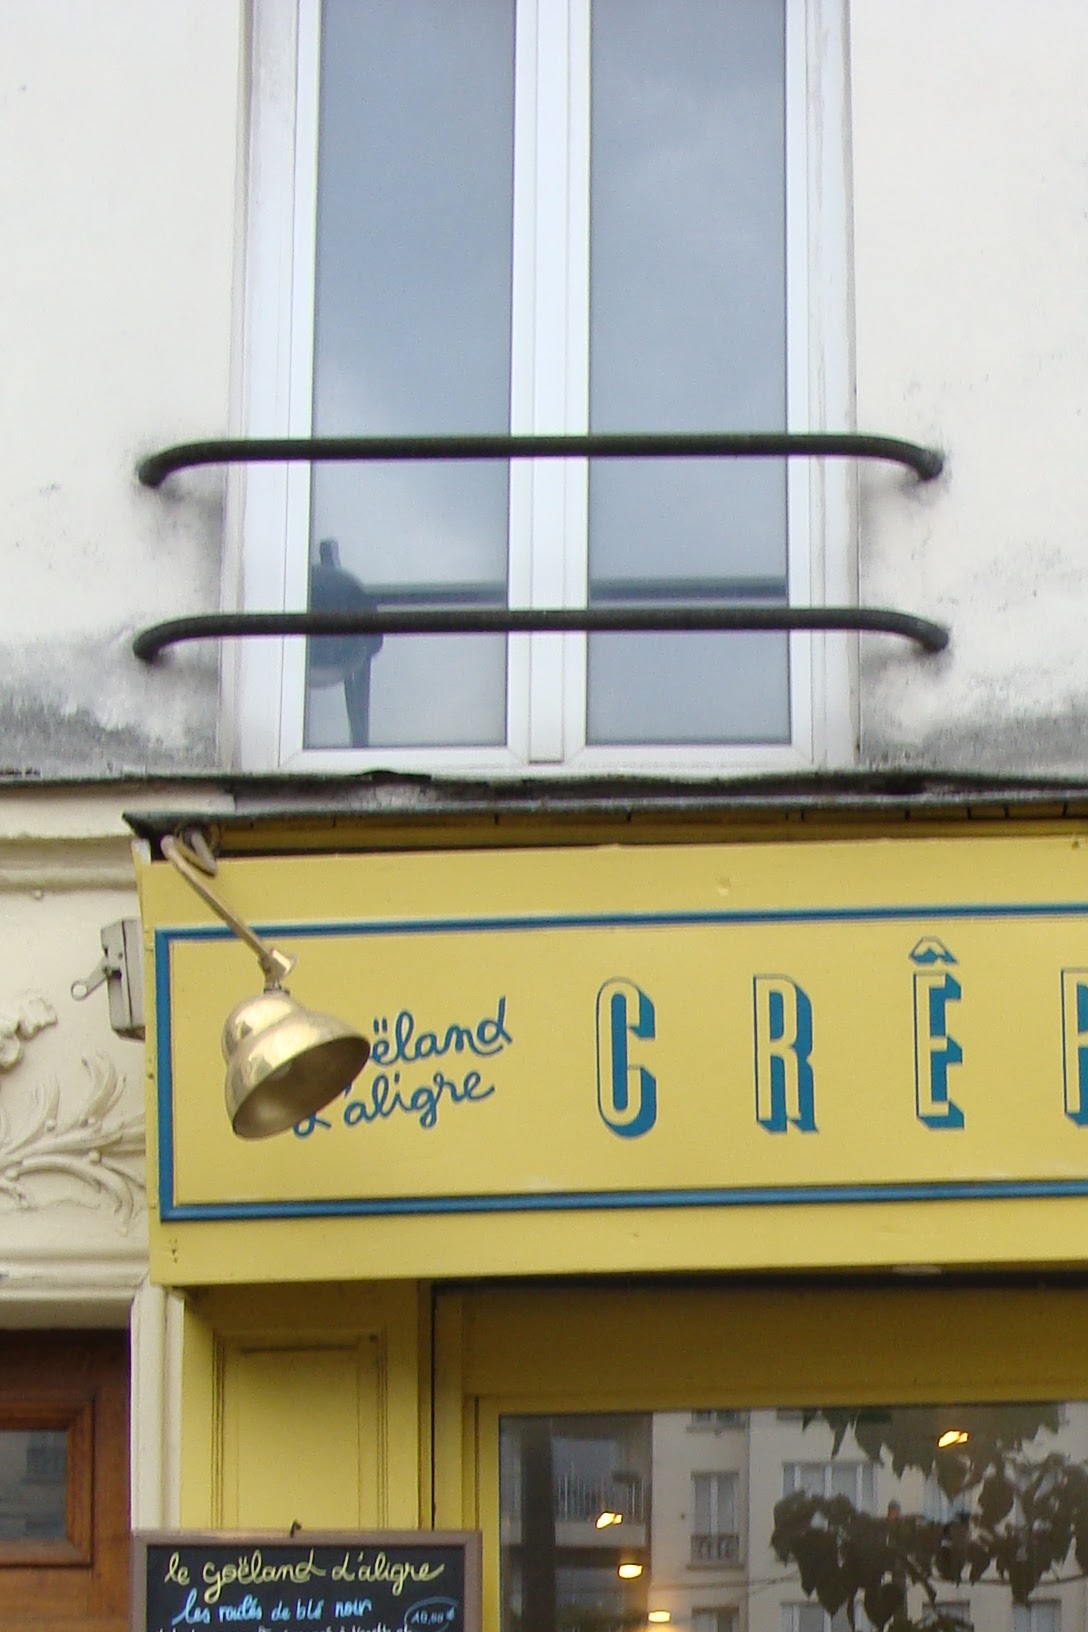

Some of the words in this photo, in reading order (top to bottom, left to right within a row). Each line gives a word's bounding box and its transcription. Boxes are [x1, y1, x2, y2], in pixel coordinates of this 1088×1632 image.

[368, 995, 513, 1067] ëland
[164, 1551, 190, 1586] le
[203, 1548, 326, 1604] goëland
[332, 1551, 445, 1596] d'aligre
[271, 1600, 291, 1622] de
[297, 1598, 324, 1621] blé
[335, 1599, 372, 1619] noir
